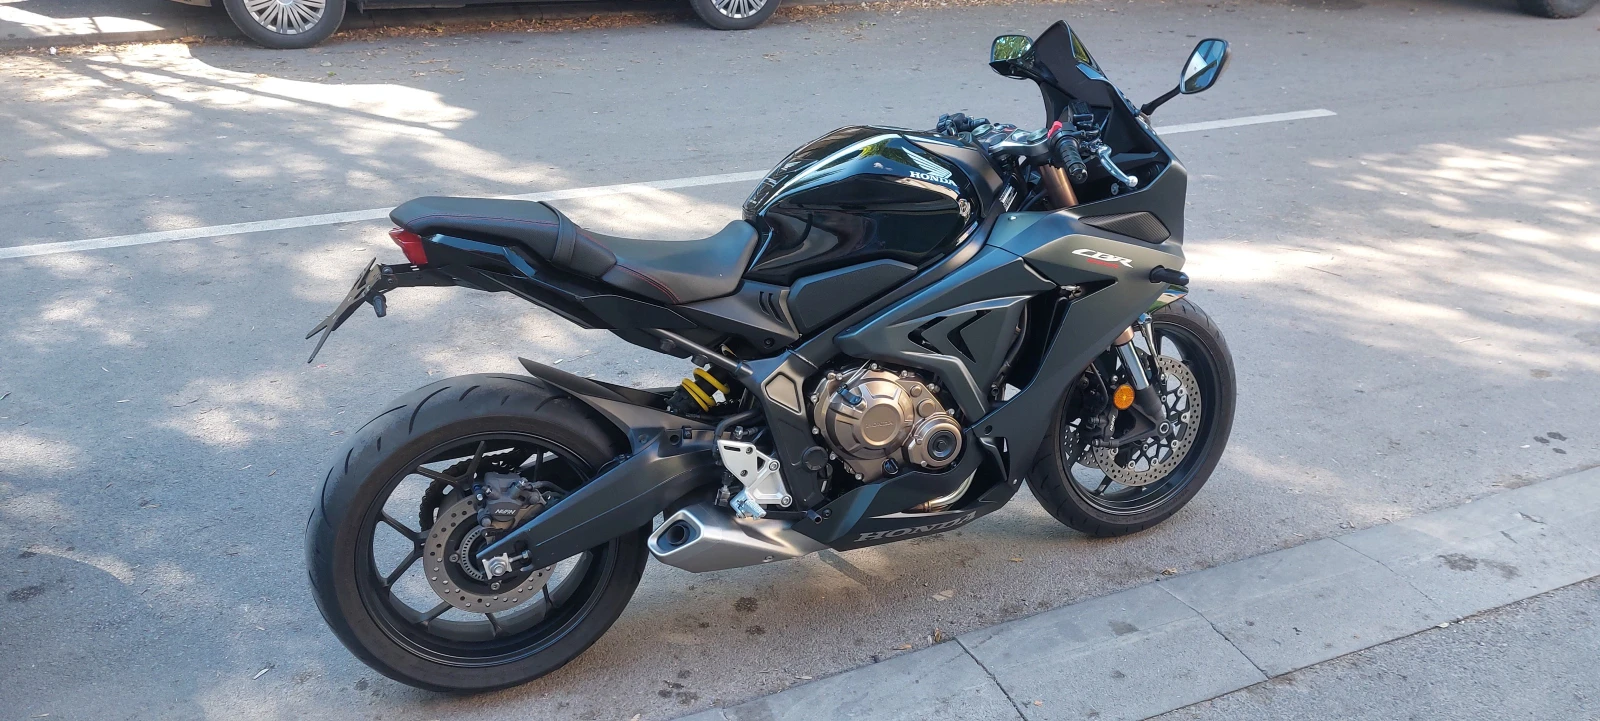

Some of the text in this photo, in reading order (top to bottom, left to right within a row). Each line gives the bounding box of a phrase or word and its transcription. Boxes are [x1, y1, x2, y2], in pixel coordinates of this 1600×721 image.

[909, 170, 958, 188] HONDA
[1071, 248, 1134, 269] CBR
[853, 510, 977, 542] HONDA
